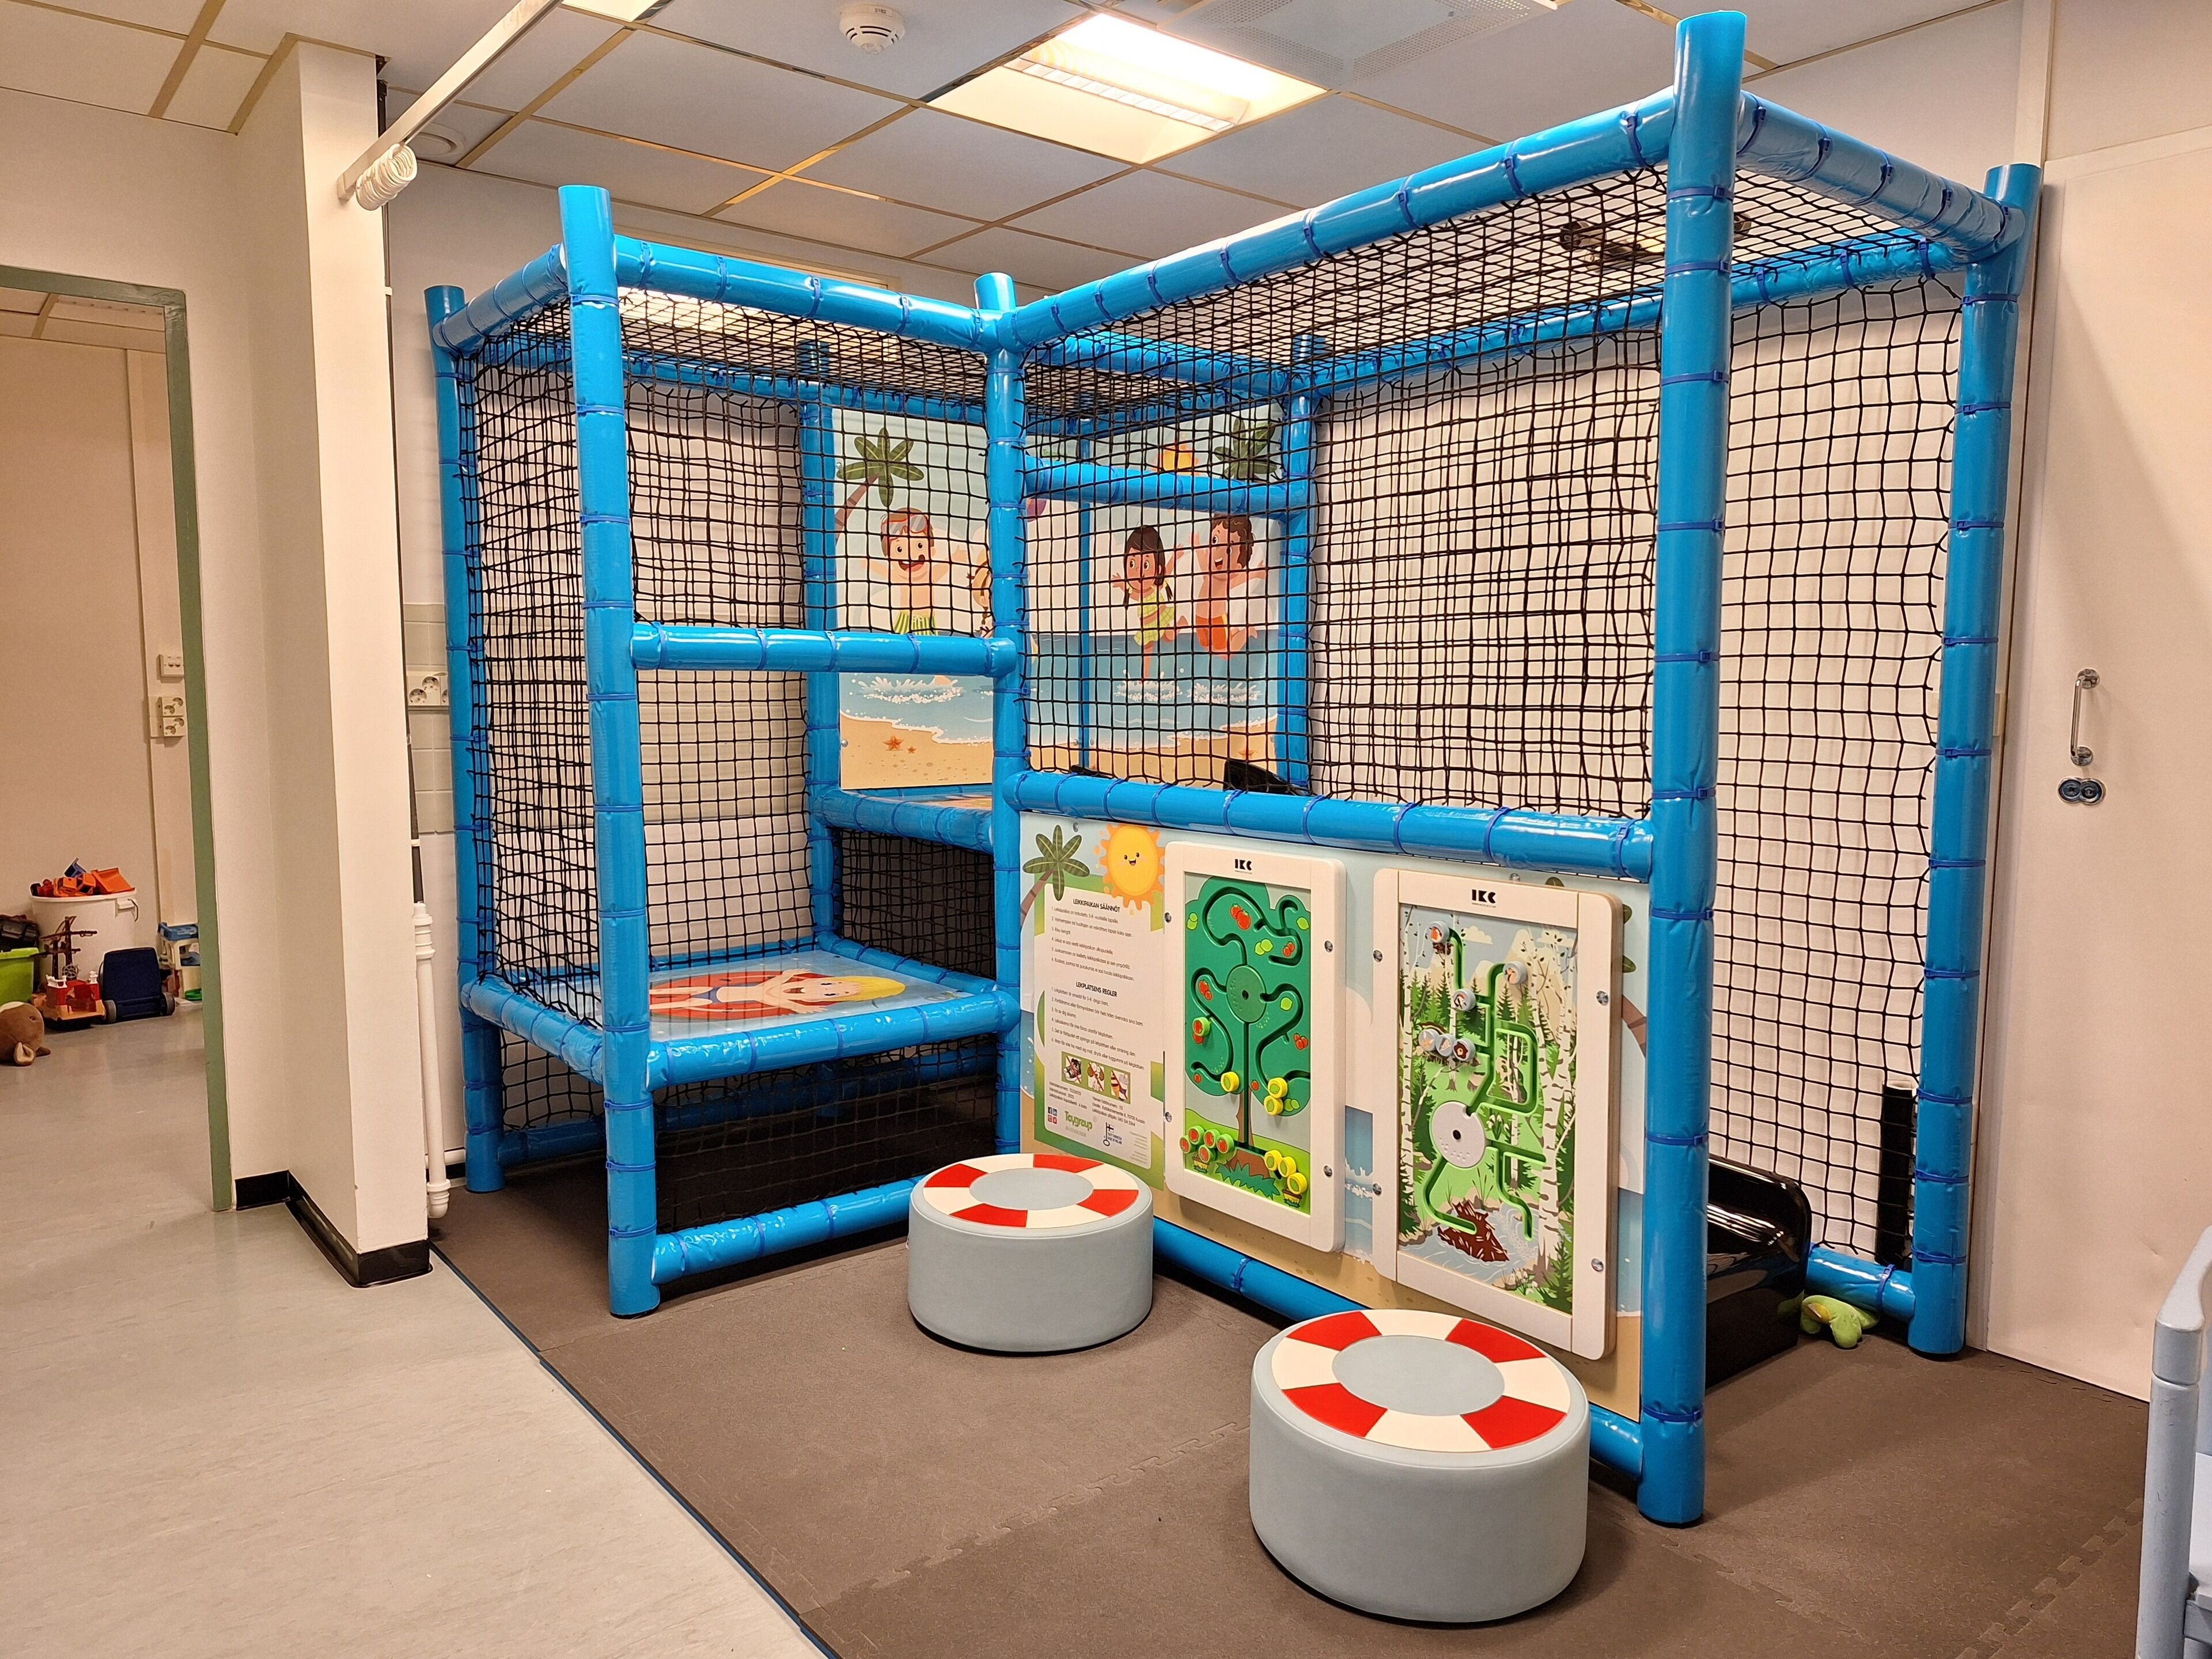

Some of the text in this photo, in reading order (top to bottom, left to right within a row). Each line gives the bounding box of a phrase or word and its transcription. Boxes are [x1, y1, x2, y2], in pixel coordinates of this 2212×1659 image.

[1073, 899, 1120, 912] LEIKKIPAIKAN SÄÄNNÖT
[1076, 982, 1117, 997] LEKPLATSENS REGLER
